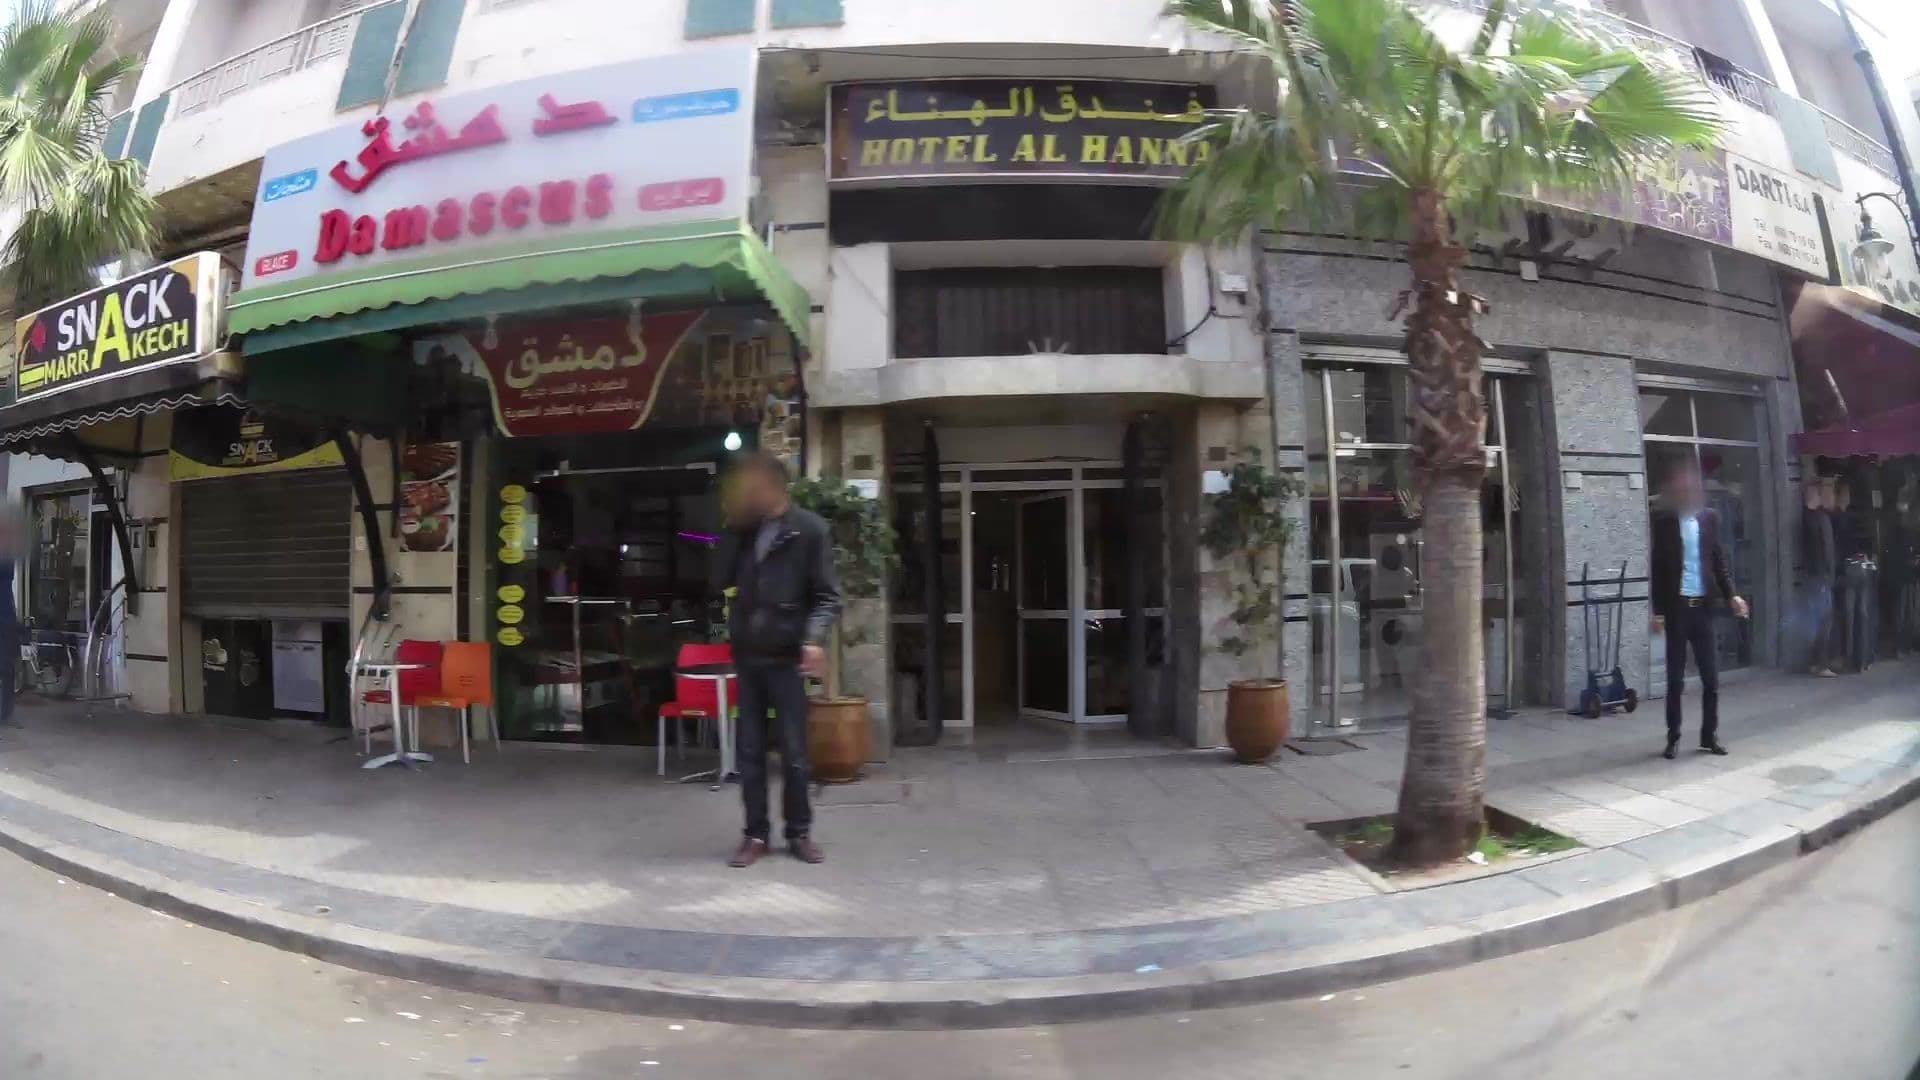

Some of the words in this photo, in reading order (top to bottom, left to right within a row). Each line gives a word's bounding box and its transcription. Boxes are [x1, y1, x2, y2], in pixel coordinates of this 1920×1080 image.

[1040, 85, 1203, 123] فندق
[861, 134, 998, 167] HOTEL
[1010, 134, 1067, 162] AL
[1734, 164, 1792, 208] DARTI
[313, 173, 614, 263] Damascus
[57, 273, 174, 370] SNACK
[505, 327, 648, 389] دمشق
